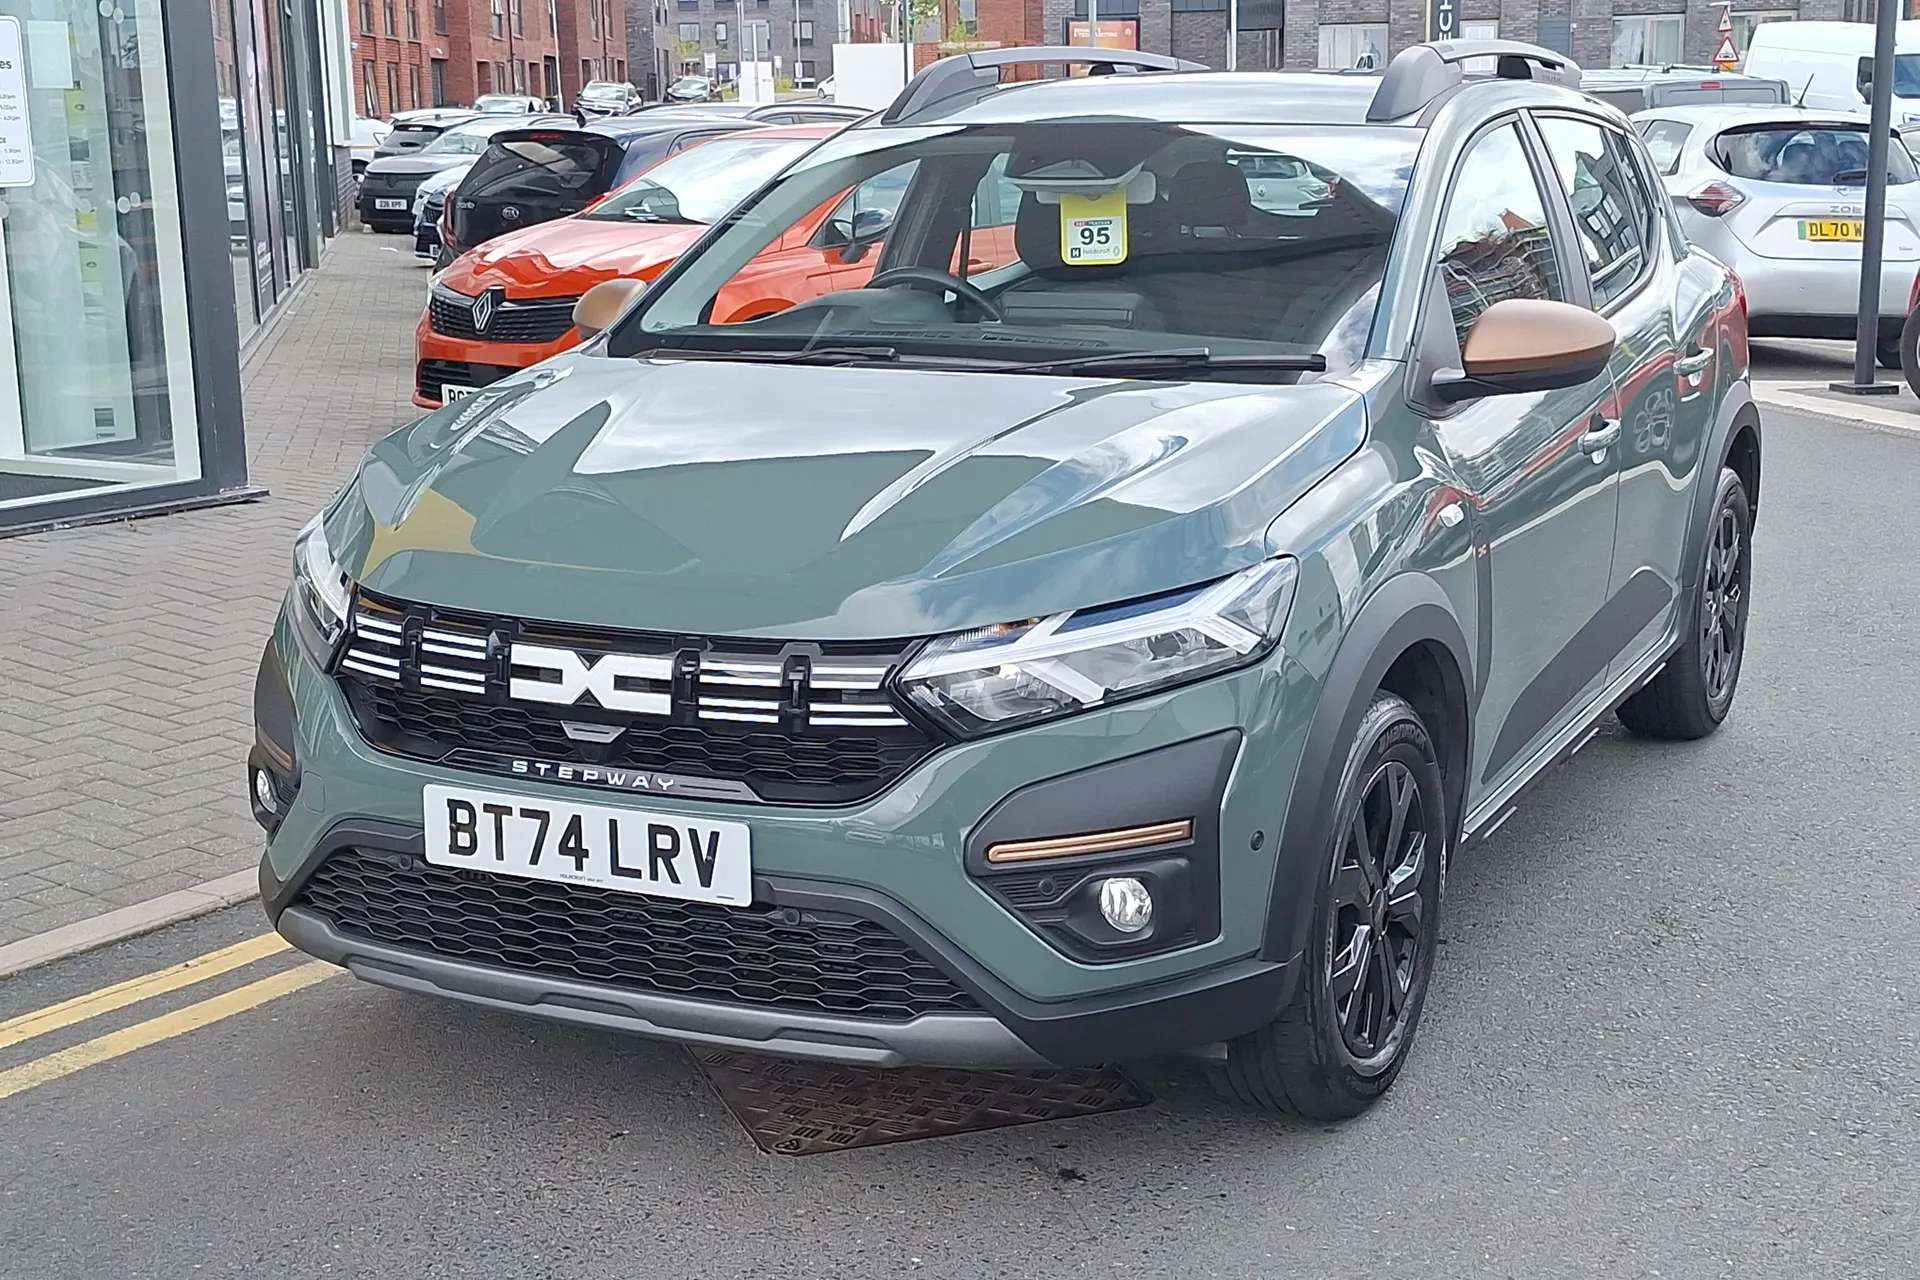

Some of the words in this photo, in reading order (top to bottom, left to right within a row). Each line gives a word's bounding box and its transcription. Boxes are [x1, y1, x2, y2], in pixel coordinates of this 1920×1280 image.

[1080, 227, 1110, 245] 95
[1810, 222, 1849, 237] DL70
[512, 760, 674, 791] STEPWAY
[446, 798, 590, 872] BT74
[609, 818, 720, 888] LRV
